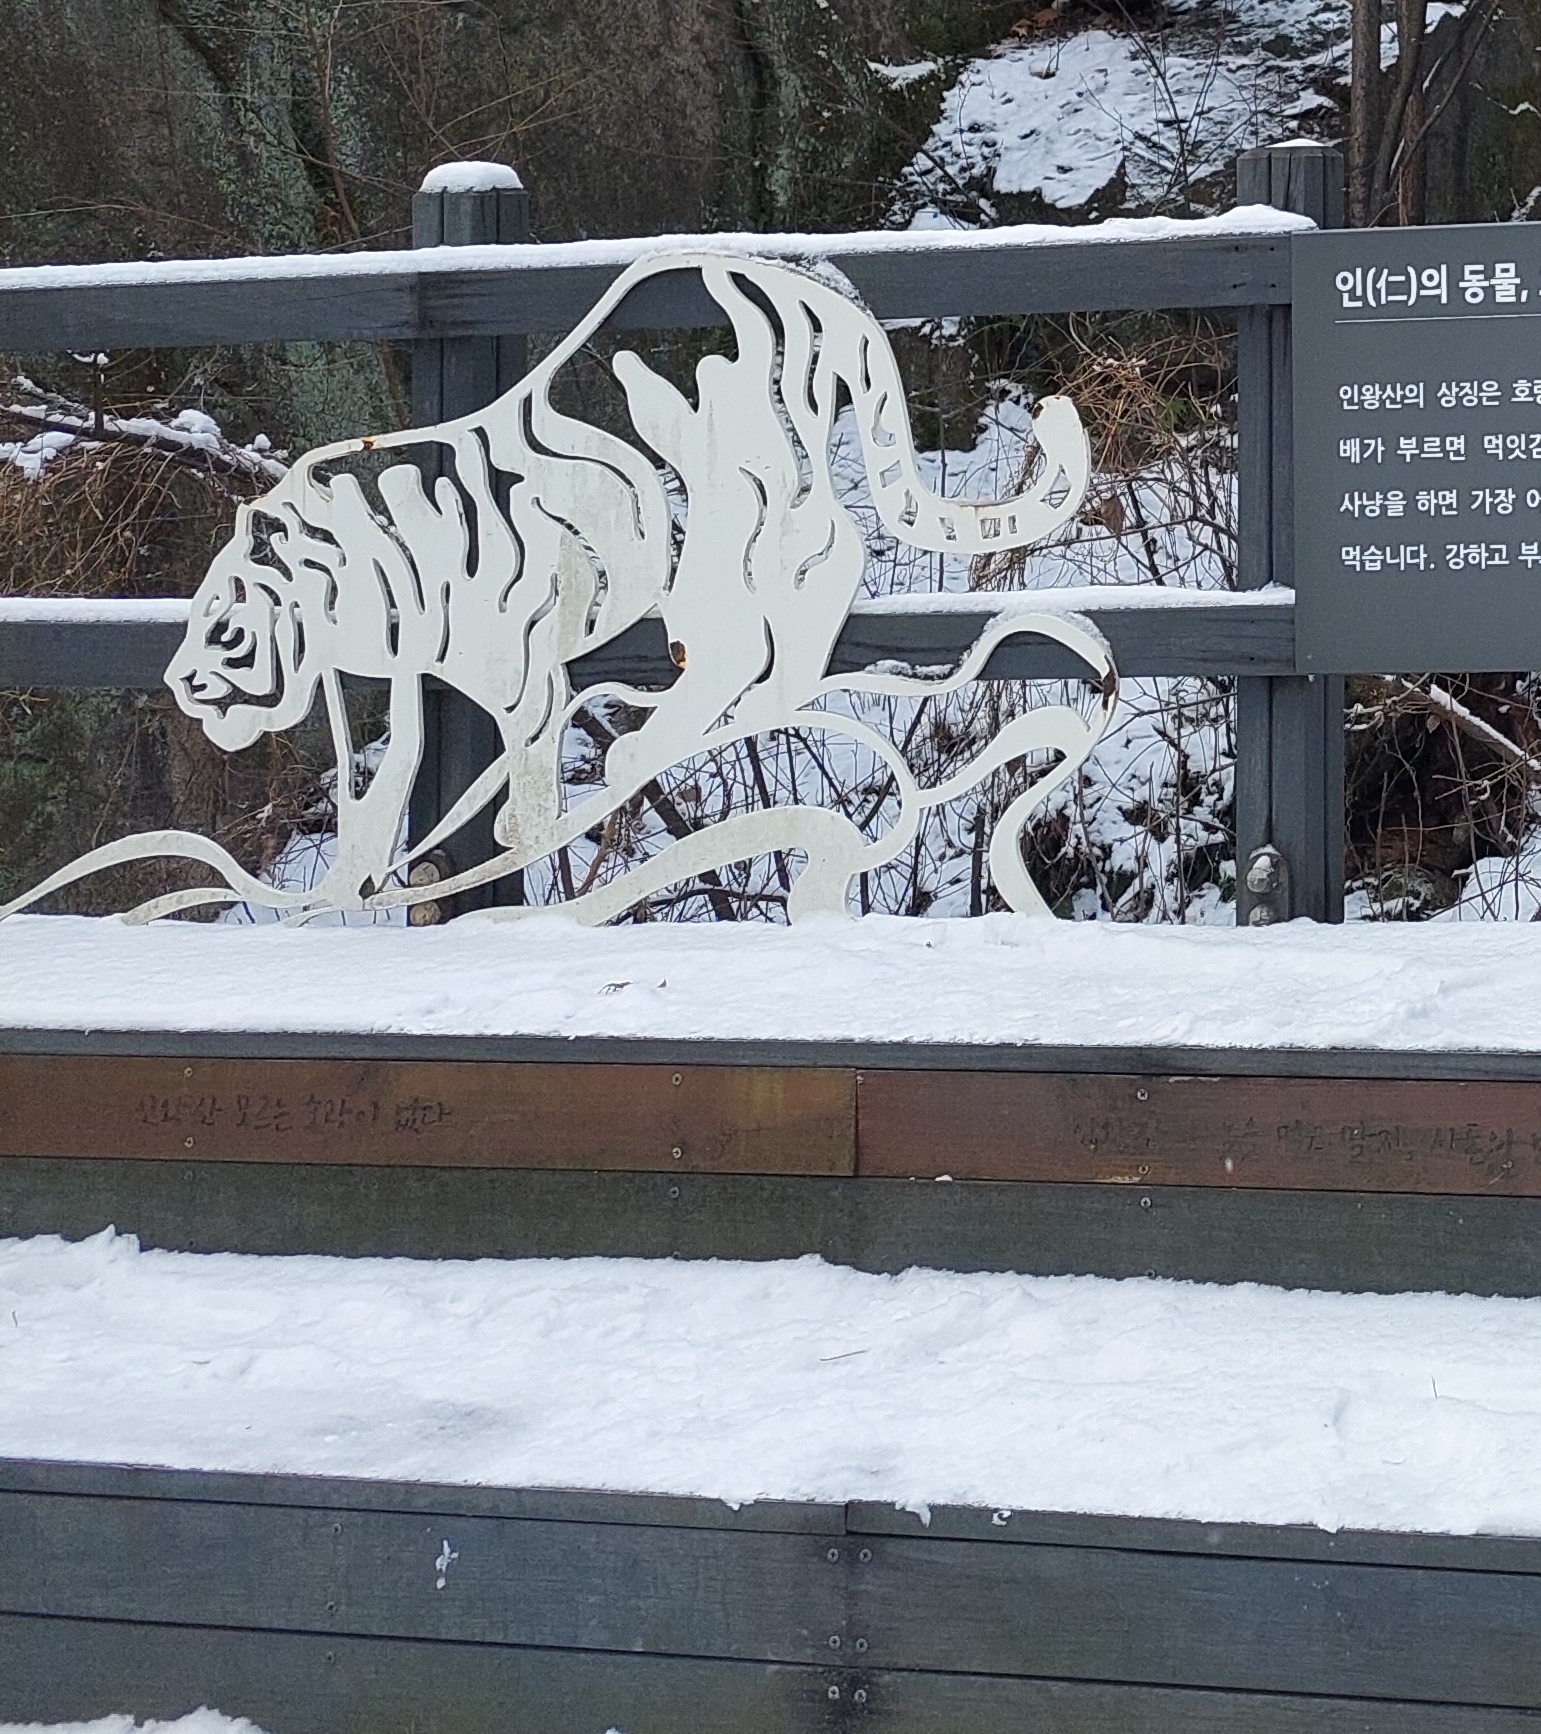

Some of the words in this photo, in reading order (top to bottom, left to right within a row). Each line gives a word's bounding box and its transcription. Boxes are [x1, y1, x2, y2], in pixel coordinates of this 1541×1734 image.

[1336, 264, 1447, 307] 인(仁)의
[1459, 263, 1528, 303] 동물,
[1339, 383, 1424, 409] 인왕산의
[1437, 381, 1501, 407] 상징은
[1340, 437, 1385, 463] 배가
[1397, 435, 1465, 462] 부르면
[1340, 491, 1407, 517] 사냥을
[1416, 489, 1458, 516] 하면
[1471, 488, 1516, 514] 가장
[1342, 544, 1434, 571] 먹습니다.
[1446, 543, 1509, 569] 강하고
